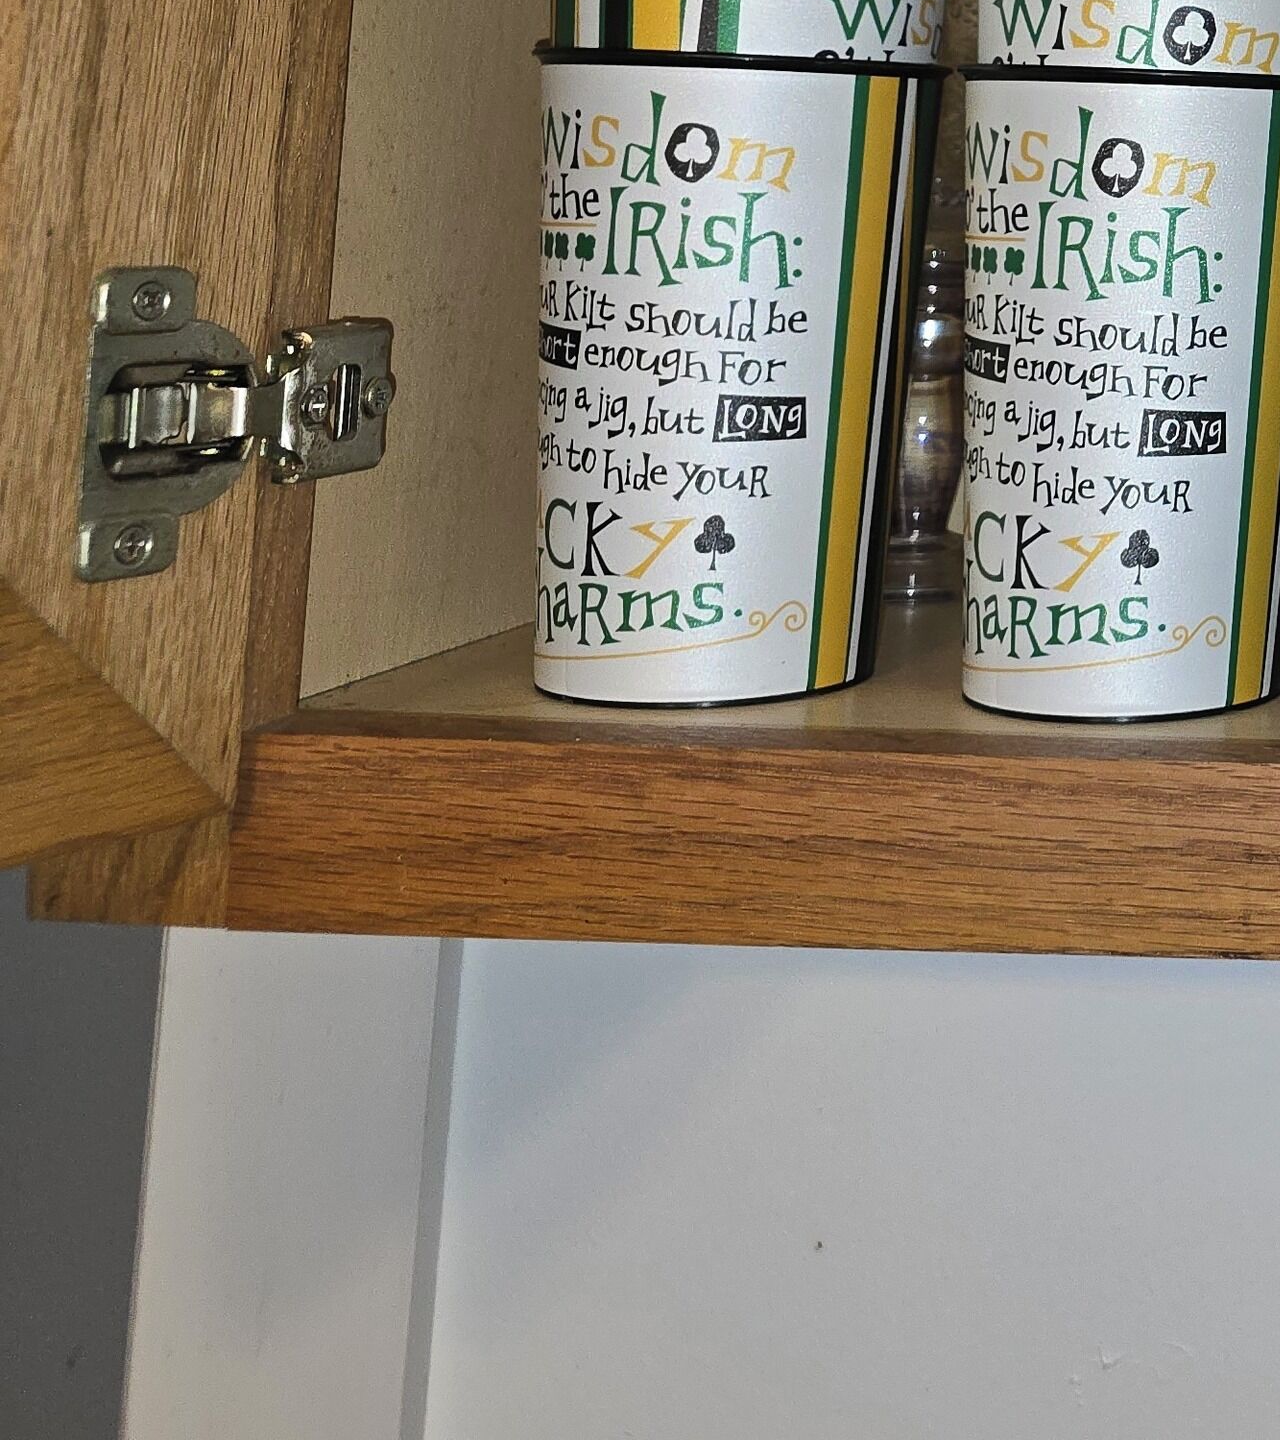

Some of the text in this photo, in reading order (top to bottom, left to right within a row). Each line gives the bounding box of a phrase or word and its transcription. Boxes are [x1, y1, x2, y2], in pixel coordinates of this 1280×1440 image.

[541, 90, 797, 192] Wisdom
[966, 106, 1219, 208] Wisdom
[976, 187, 1030, 235] the
[625, 298, 756, 342] should
[763, 301, 808, 336] be
[1053, 312, 1180, 357] should
[1187, 315, 1228, 350] be
[584, 343, 713, 387] enough
[1013, 357, 1136, 401] enough
[574, 386, 592, 413] a
[588, 386, 636, 440] jig,
[641, 396, 705, 436] but
[1004, 400, 1022, 426] a
[1017, 399, 1064, 453] jig,
[1069, 410, 1131, 450] but
[566, 438, 597, 474] to
[603, 449, 668, 495] hide
[995, 451, 1026, 487] to
[1032, 462, 1096, 509] hide
